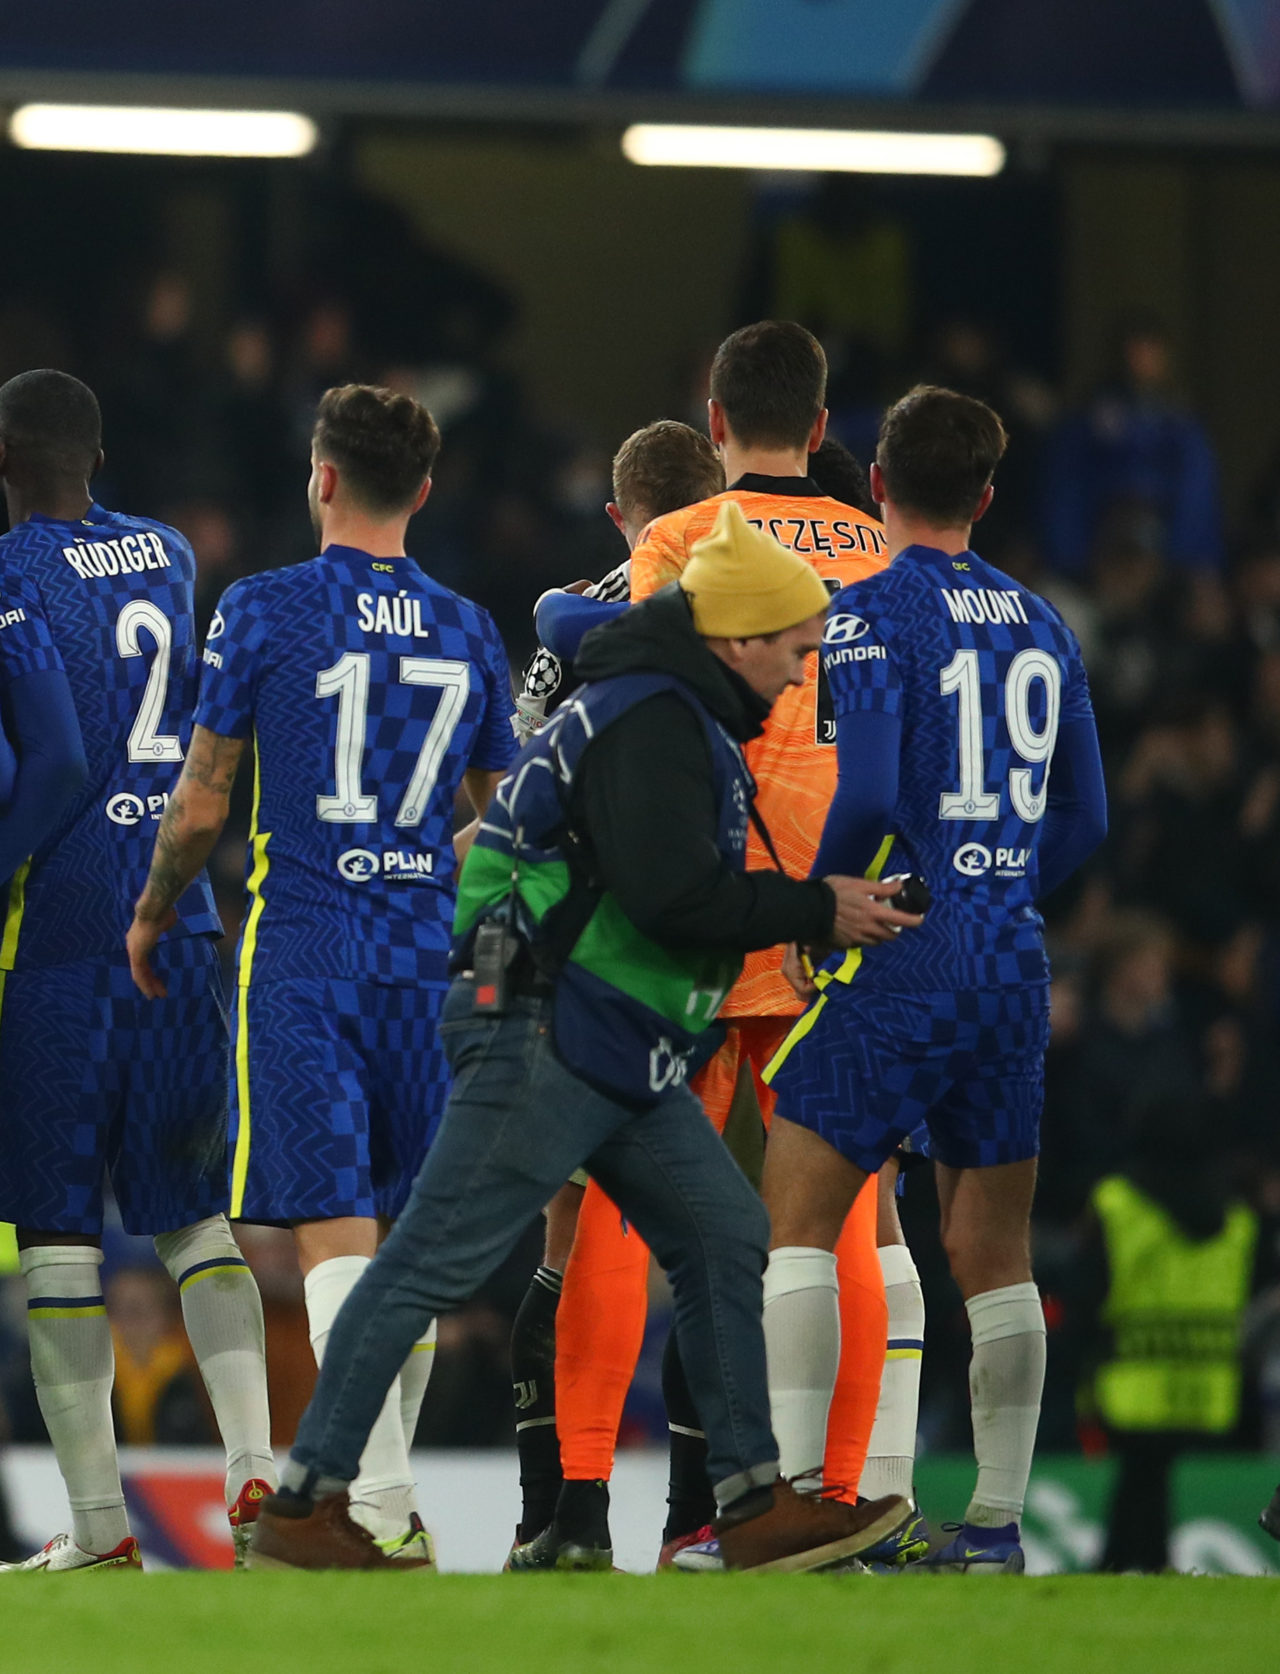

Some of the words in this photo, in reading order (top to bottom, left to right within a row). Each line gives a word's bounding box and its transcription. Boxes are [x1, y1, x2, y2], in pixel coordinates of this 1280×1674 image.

[62, 531, 172, 580] RÜDIGER
[371, 561, 395, 574] CFC
[356, 589, 429, 638] SAÚL
[940, 588, 1030, 625] MOUNT
[115, 599, 185, 763] 2
[314, 651, 470, 828] 17
[938, 648, 1062, 824] 19
[383, 850, 433, 873] PLAN
